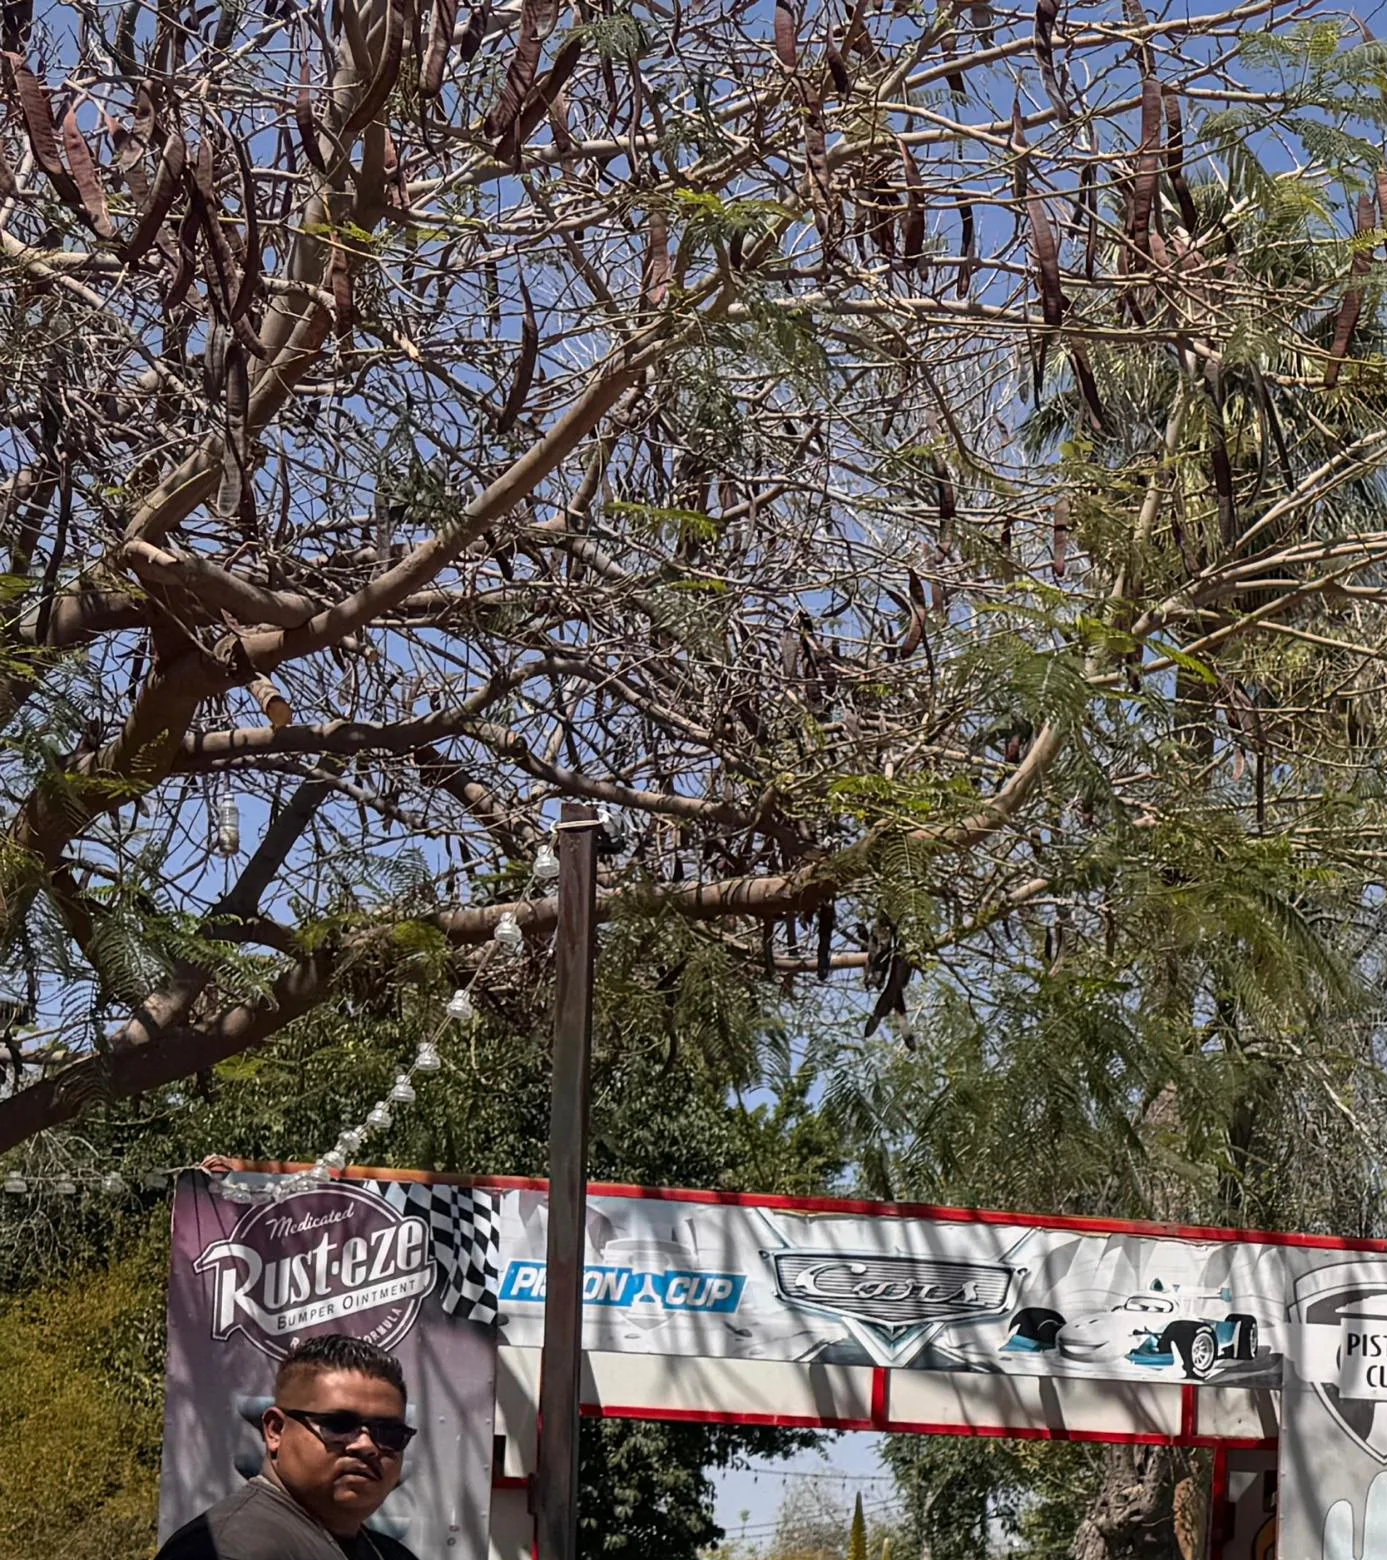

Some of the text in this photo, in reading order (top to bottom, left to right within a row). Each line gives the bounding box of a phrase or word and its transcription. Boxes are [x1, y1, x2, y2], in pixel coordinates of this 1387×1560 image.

[265, 1202, 354, 1240] Medicated
[277, 1279, 416, 1330] BUMPER OINTMENT
[510, 1266, 734, 1308] PION CUP
